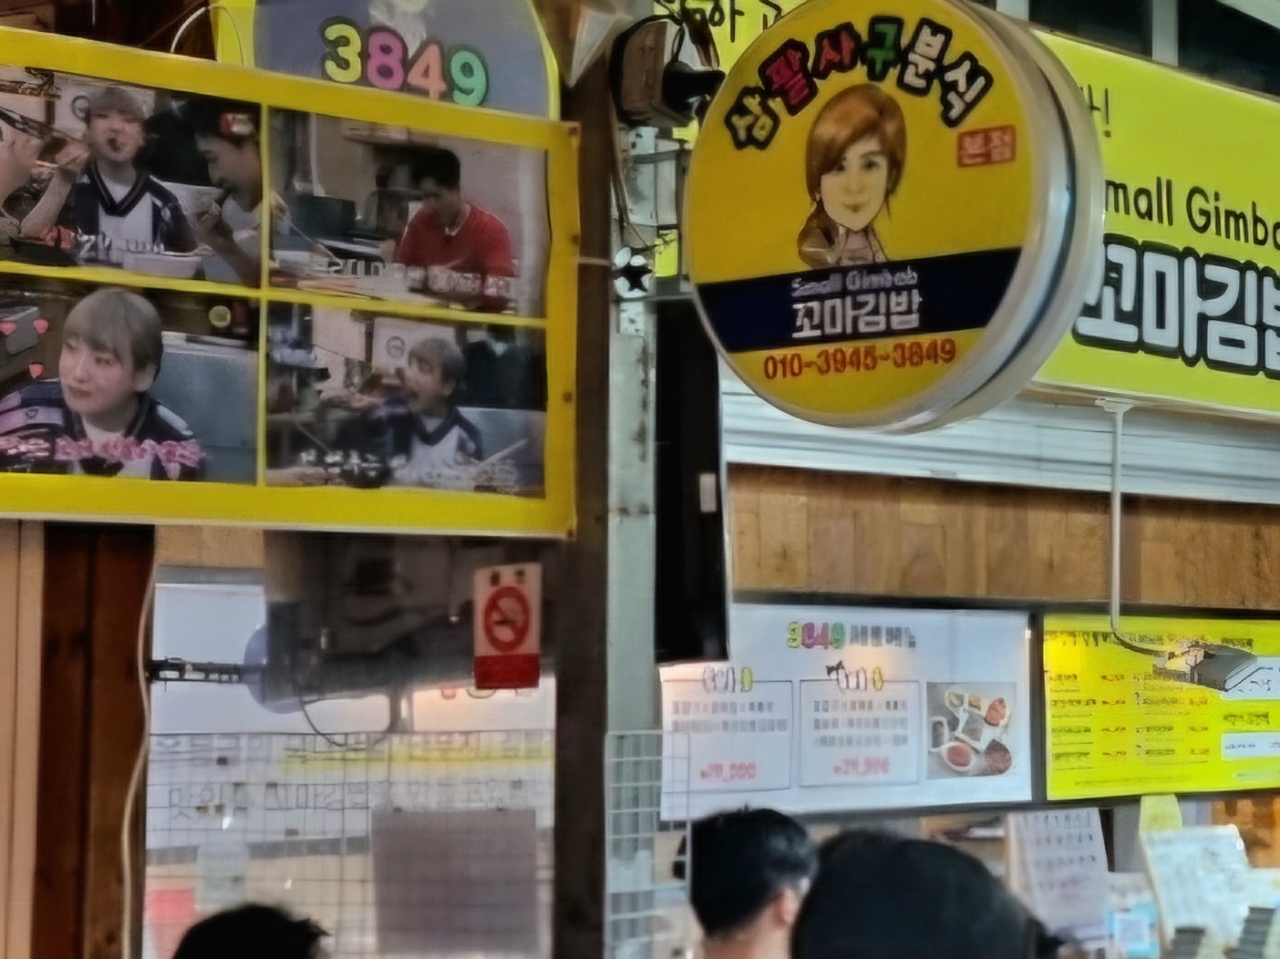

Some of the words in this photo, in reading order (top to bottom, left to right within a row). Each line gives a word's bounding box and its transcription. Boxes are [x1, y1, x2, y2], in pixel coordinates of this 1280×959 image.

[322, 18, 489, 107] 3849
[1105, 176, 1174, 226] mall
[792, 289, 923, 338] 꼬마김밥
